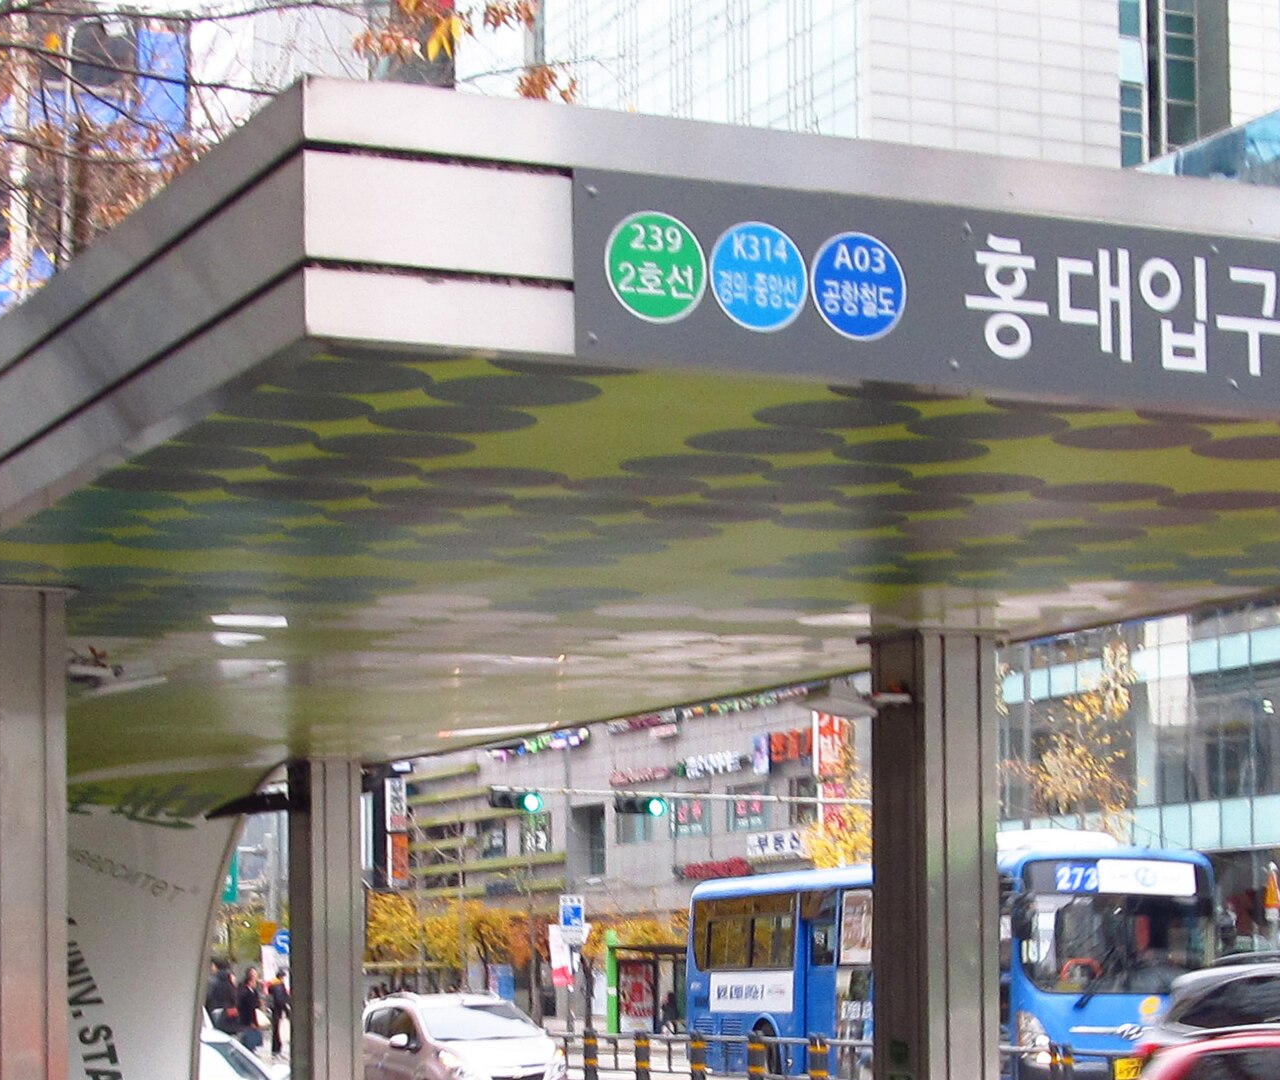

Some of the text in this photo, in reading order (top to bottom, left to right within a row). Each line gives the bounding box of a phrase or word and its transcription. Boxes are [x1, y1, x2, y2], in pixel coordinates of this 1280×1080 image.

[630, 223, 683, 253] 239
[731, 232, 789, 264] K314
[833, 243, 886, 274] A03
[618, 260, 697, 301] 2호선
[822, 279, 898, 318] 공항철도
